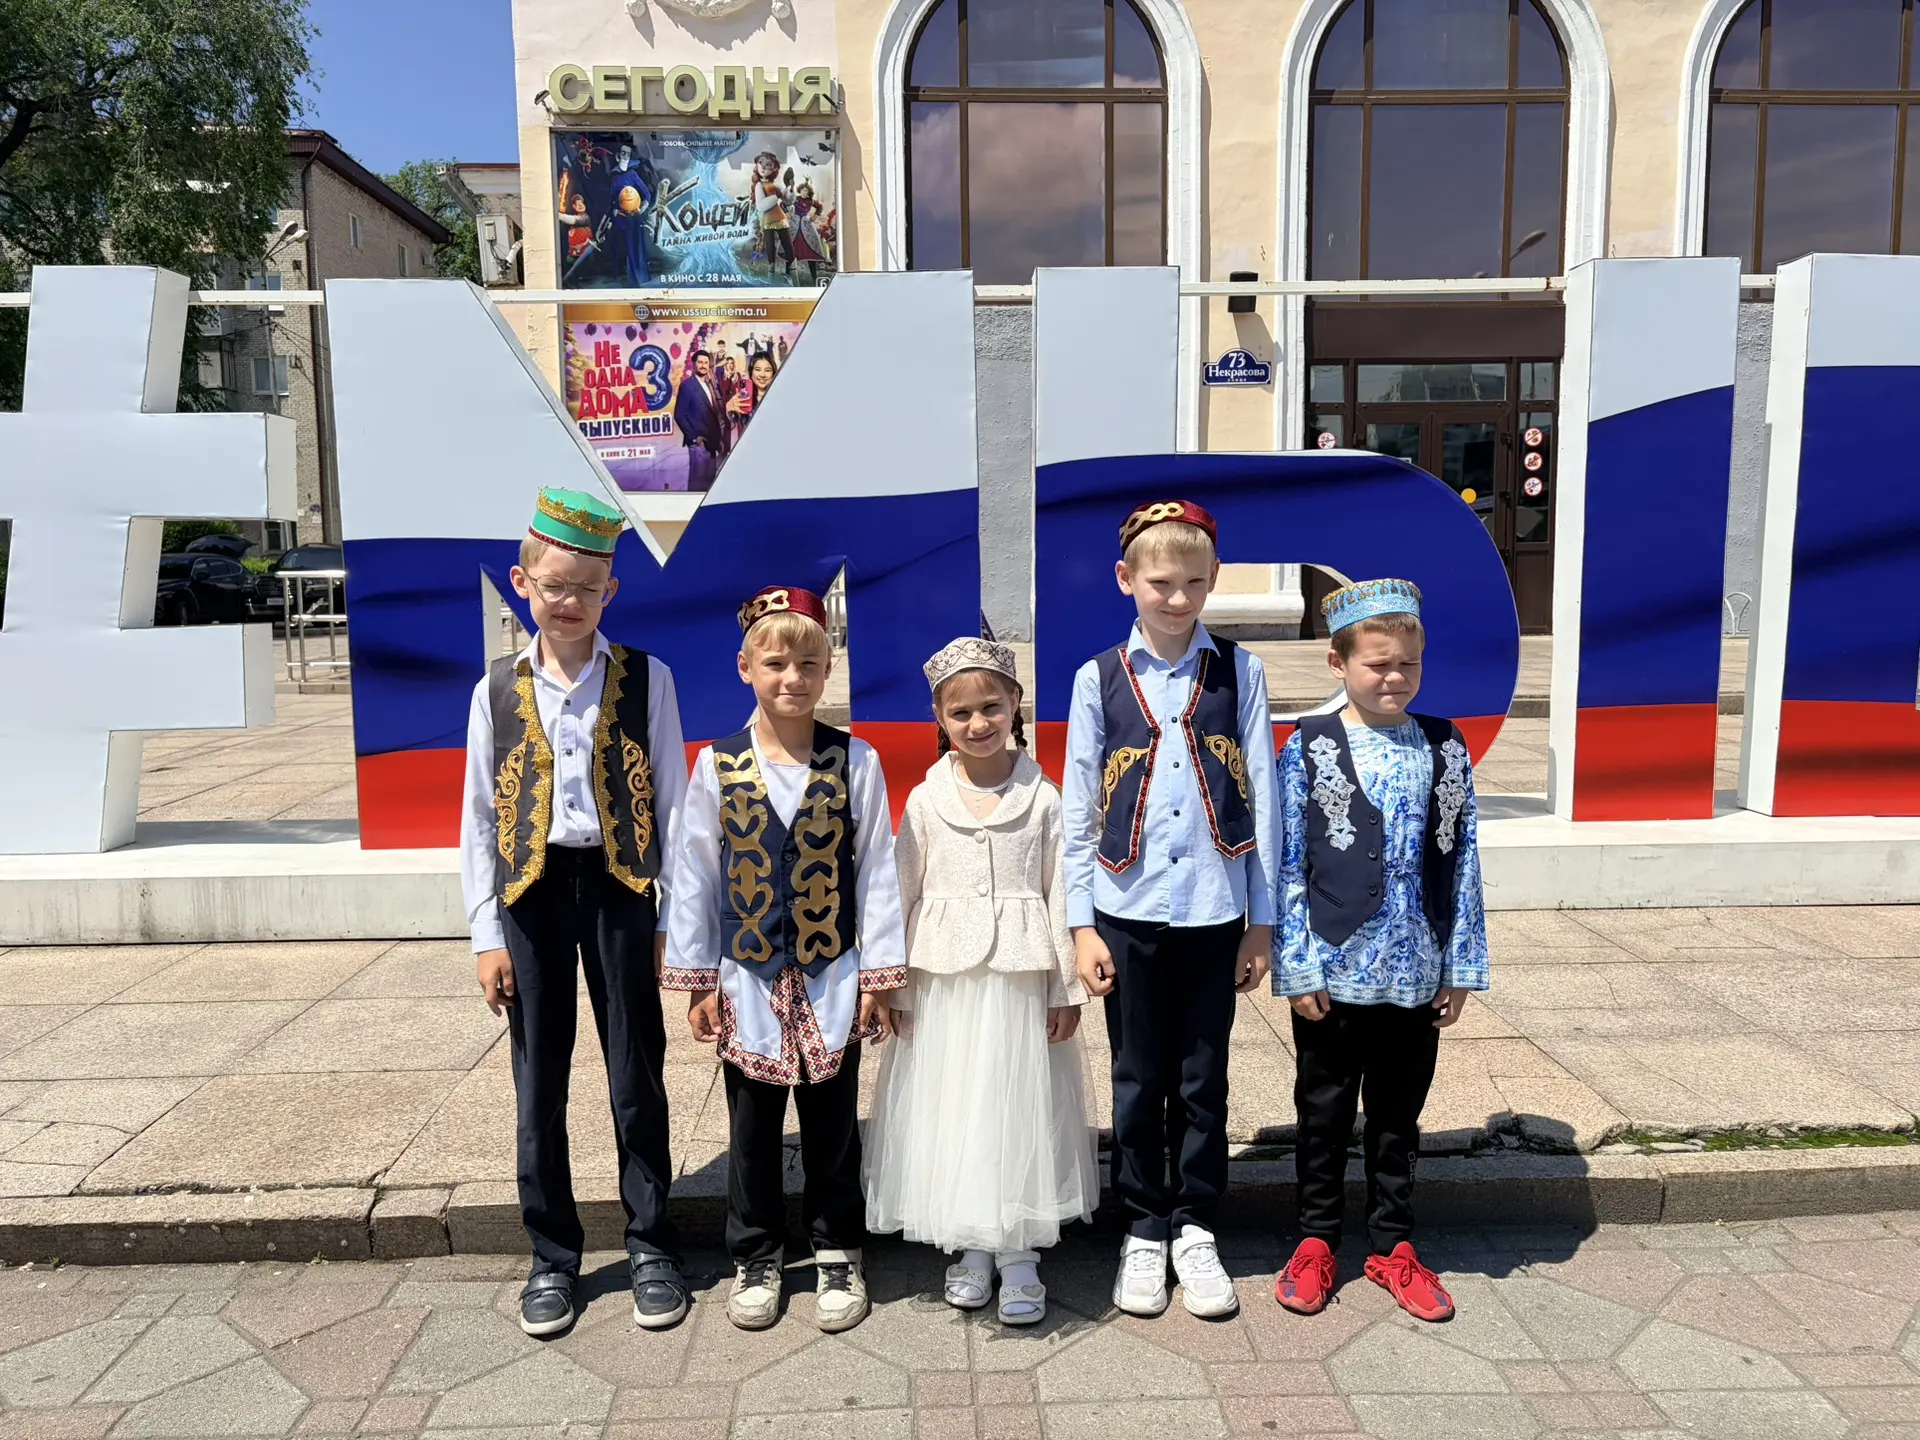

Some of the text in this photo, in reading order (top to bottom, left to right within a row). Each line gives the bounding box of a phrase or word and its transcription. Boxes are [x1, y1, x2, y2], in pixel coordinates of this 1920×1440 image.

[549, 63, 831, 121] СЕГОДНЯ
[662, 229, 749, 247] ТАЙНА ЖИВОЙ ВОДЫ
[660, 273, 742, 283] В КИНО С 28 МАЯ
[651, 306, 767, 317] www.ussurcinema.ru
[1228, 352, 1246, 368] 73
[584, 365, 637, 389] ОДНА
[628, 344, 673, 411] 3
[1208, 365, 1266, 379] Некрасова
[577, 386, 649, 420] ДОМА
[579, 414, 671, 437] ВЫПУСКНОЙ
[627, 449, 637, 457] 21
